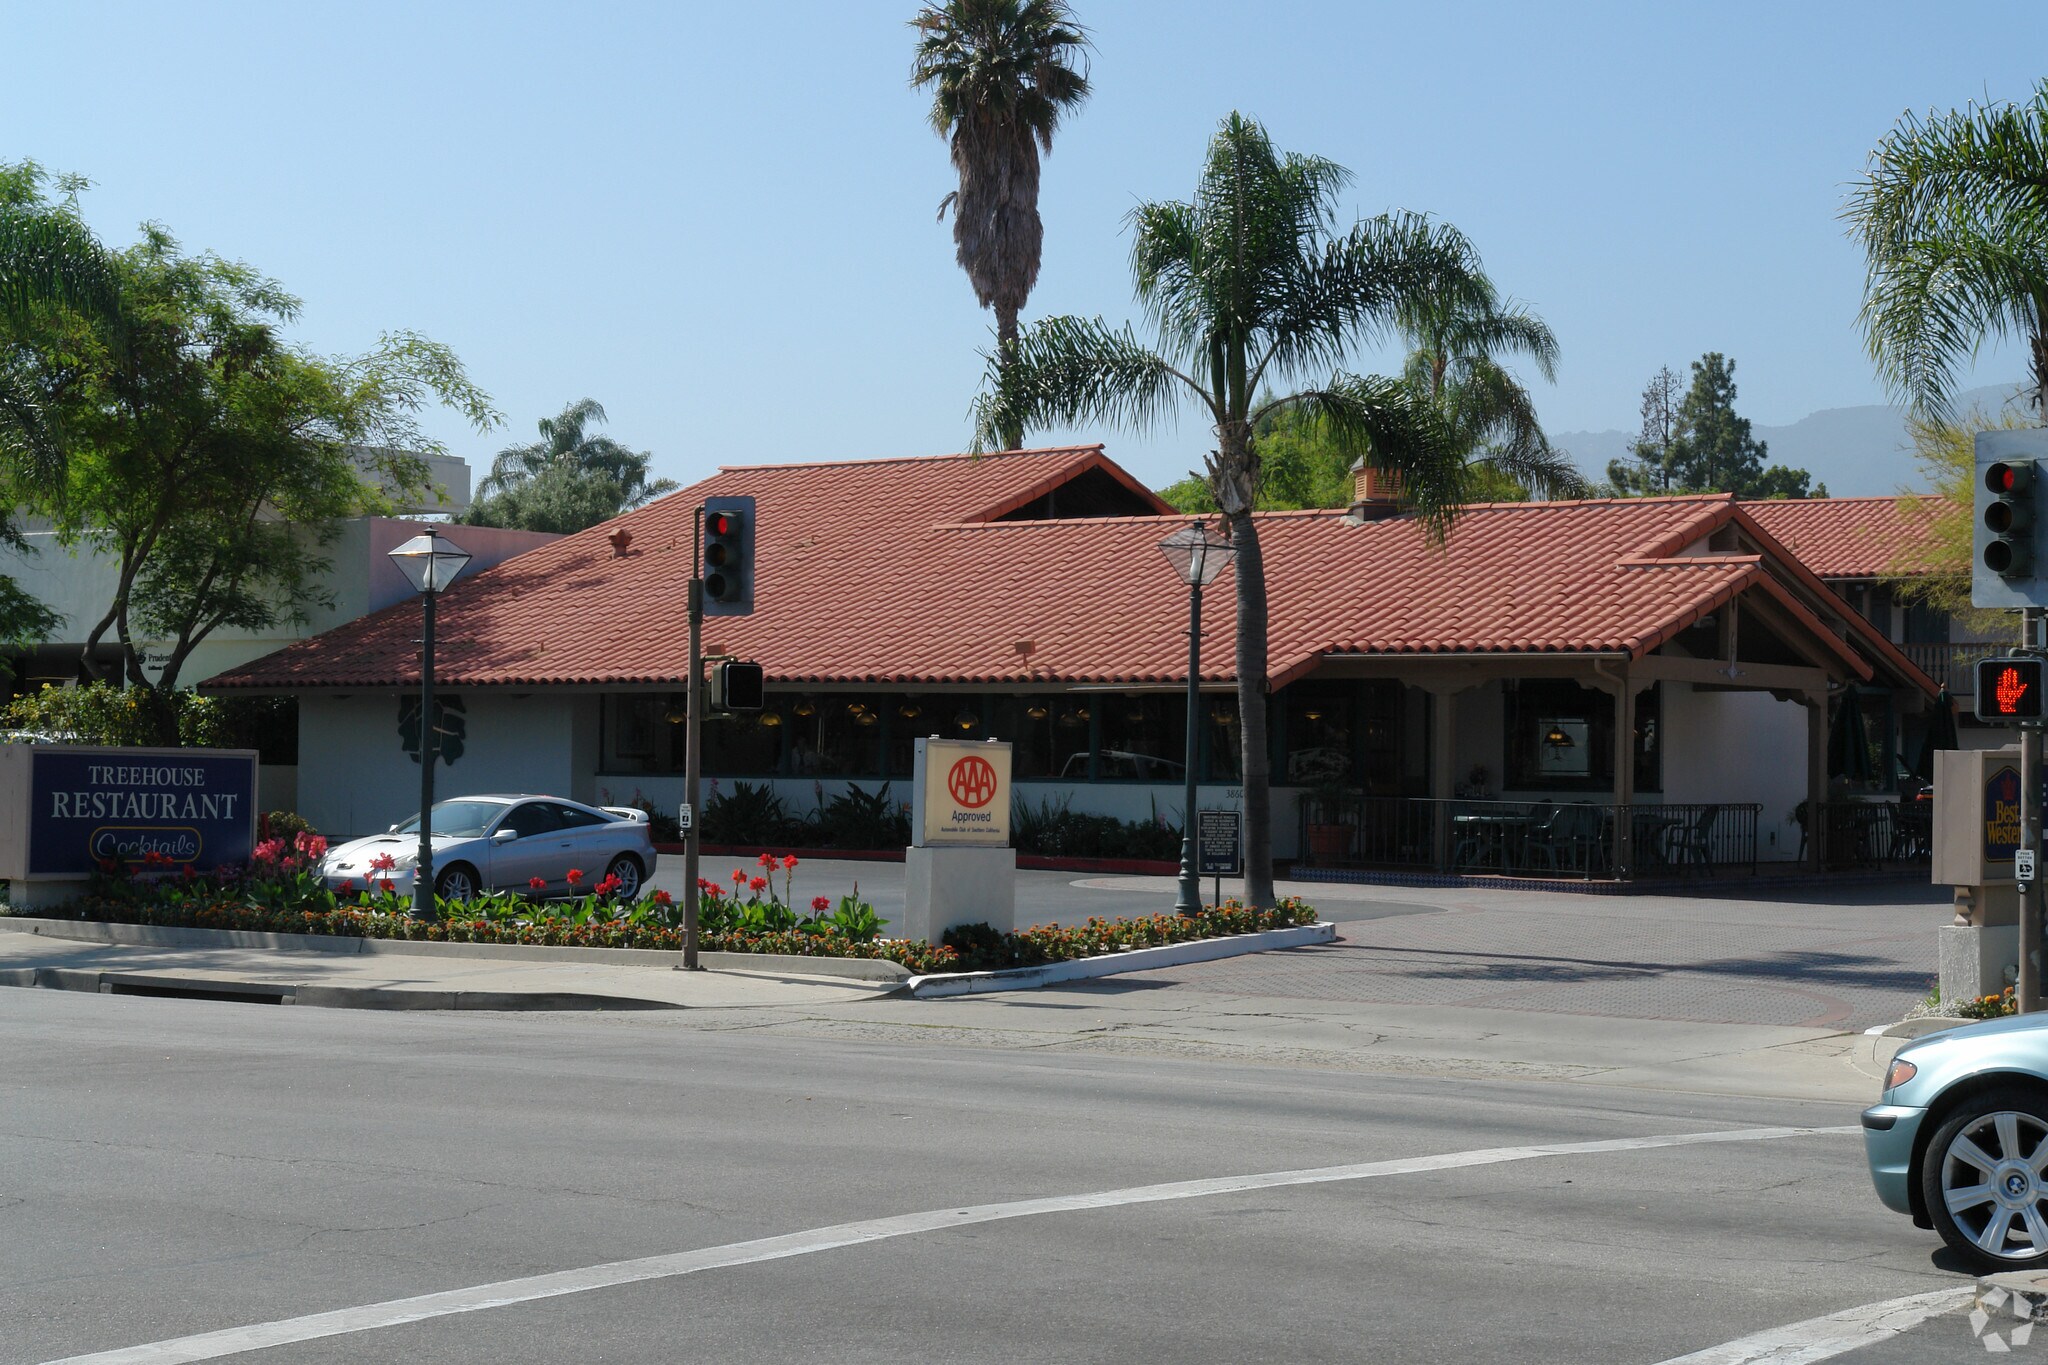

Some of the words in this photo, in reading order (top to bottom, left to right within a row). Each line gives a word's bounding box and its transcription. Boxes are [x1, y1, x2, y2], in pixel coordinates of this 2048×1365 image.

[149, 653, 171, 662] Prudent
[88, 765, 205, 787] TREEHOUSE
[951, 759, 995, 806] AAA
[51, 791, 238, 820] RESTAURANT
[951, 810, 991, 824] Approved
[1995, 800, 2019, 824] Best
[1987, 820, 2021, 844] Wester
[97, 833, 195, 857] Cocktails
